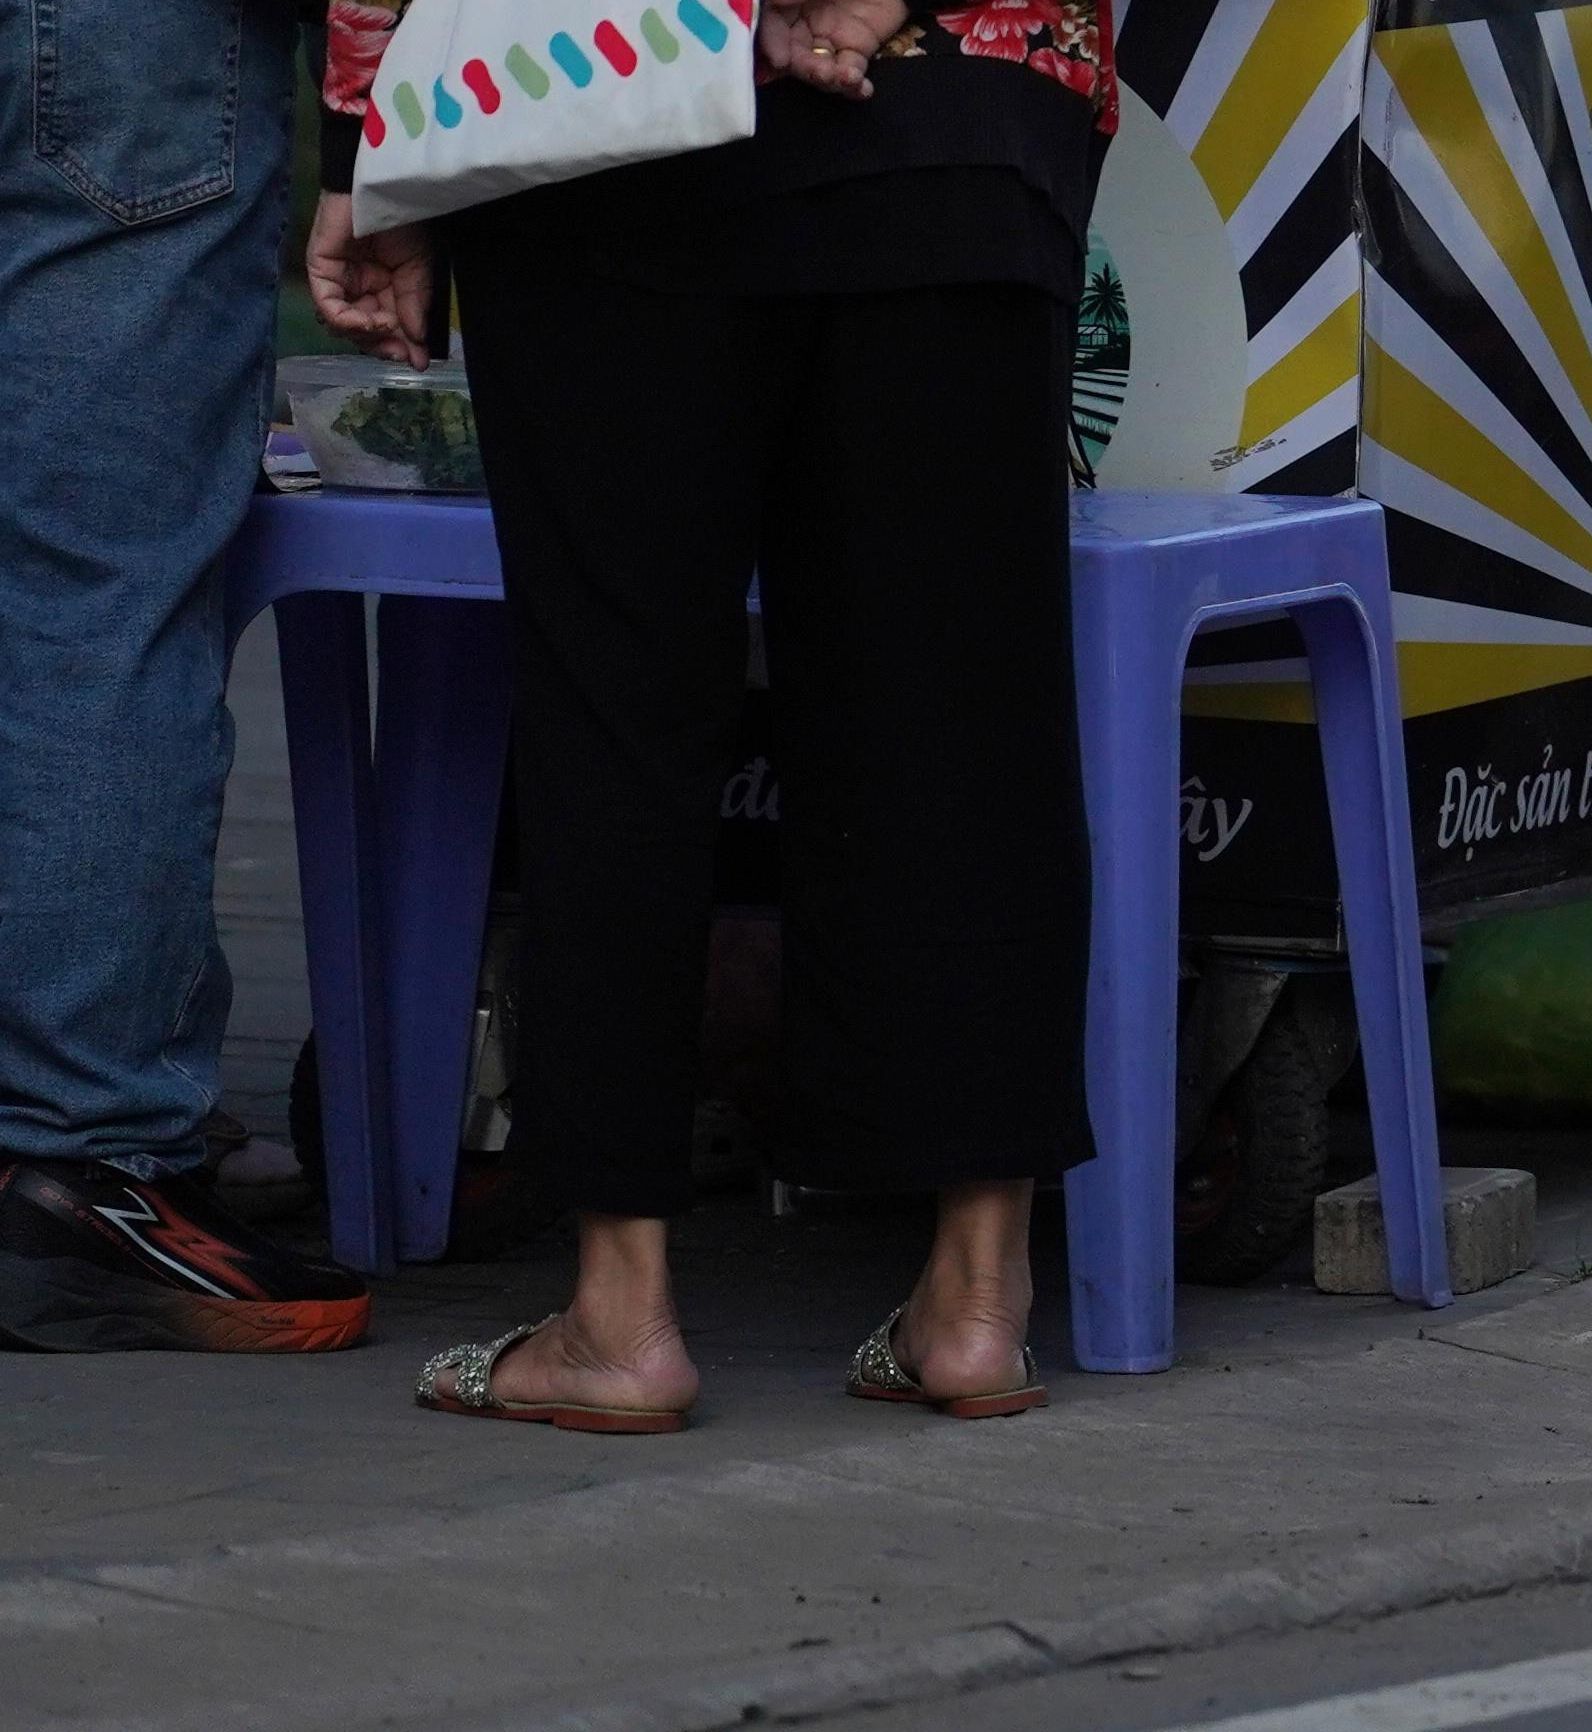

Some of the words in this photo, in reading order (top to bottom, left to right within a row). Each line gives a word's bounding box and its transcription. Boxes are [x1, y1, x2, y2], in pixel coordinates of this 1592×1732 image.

[1178, 775, 1254, 862] ây
[1436, 763, 1505, 862] Đặc
[1509, 744, 1571, 834] sản
